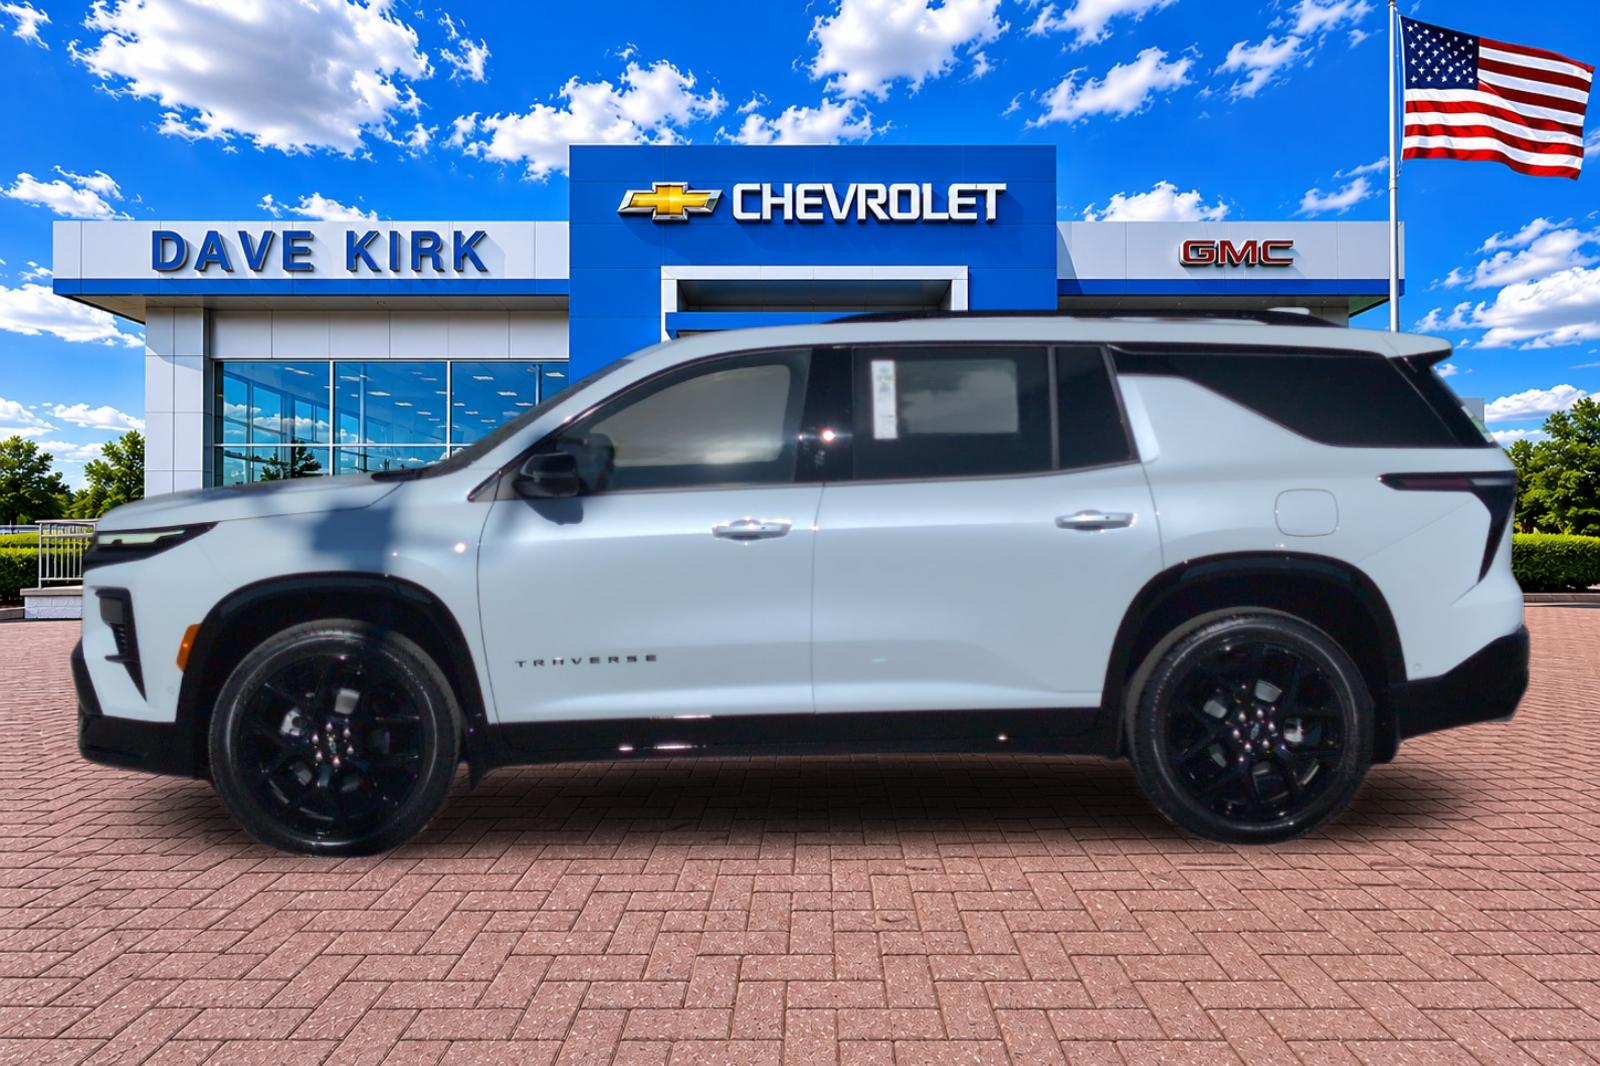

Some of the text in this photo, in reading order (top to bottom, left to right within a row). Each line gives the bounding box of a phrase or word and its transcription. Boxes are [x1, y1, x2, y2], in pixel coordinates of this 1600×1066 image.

[732, 183, 1007, 222] CHEVROLET
[151, 230, 489, 272] DAVE KIRK
[1179, 239, 1294, 267] GMC
[514, 654, 657, 668] TRAVERSE
